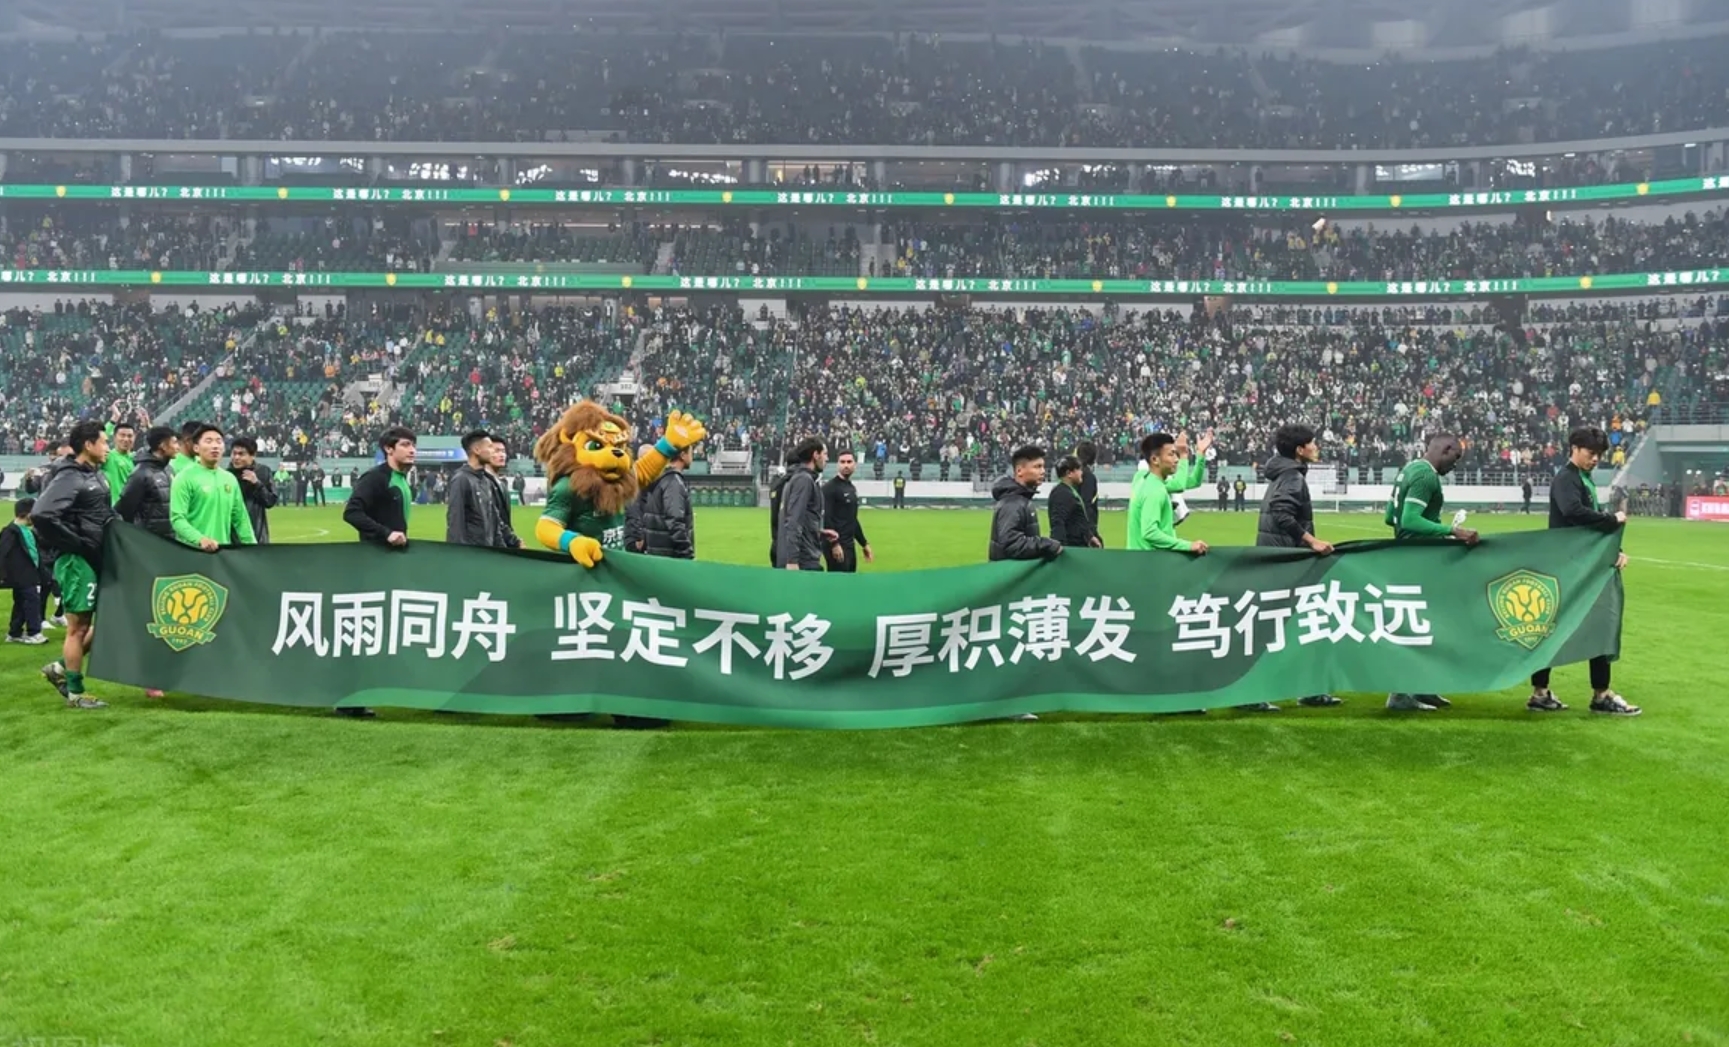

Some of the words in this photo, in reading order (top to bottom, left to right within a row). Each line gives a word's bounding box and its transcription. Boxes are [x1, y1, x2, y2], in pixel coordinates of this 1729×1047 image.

[159, 625, 204, 640] GUOAN
[271, 590, 516, 662] 风雨同舟
[551, 591, 834, 680] 坚定不移
[868, 594, 1137, 678] 厚积薄发
[1167, 580, 1434, 659] 笃行致远
